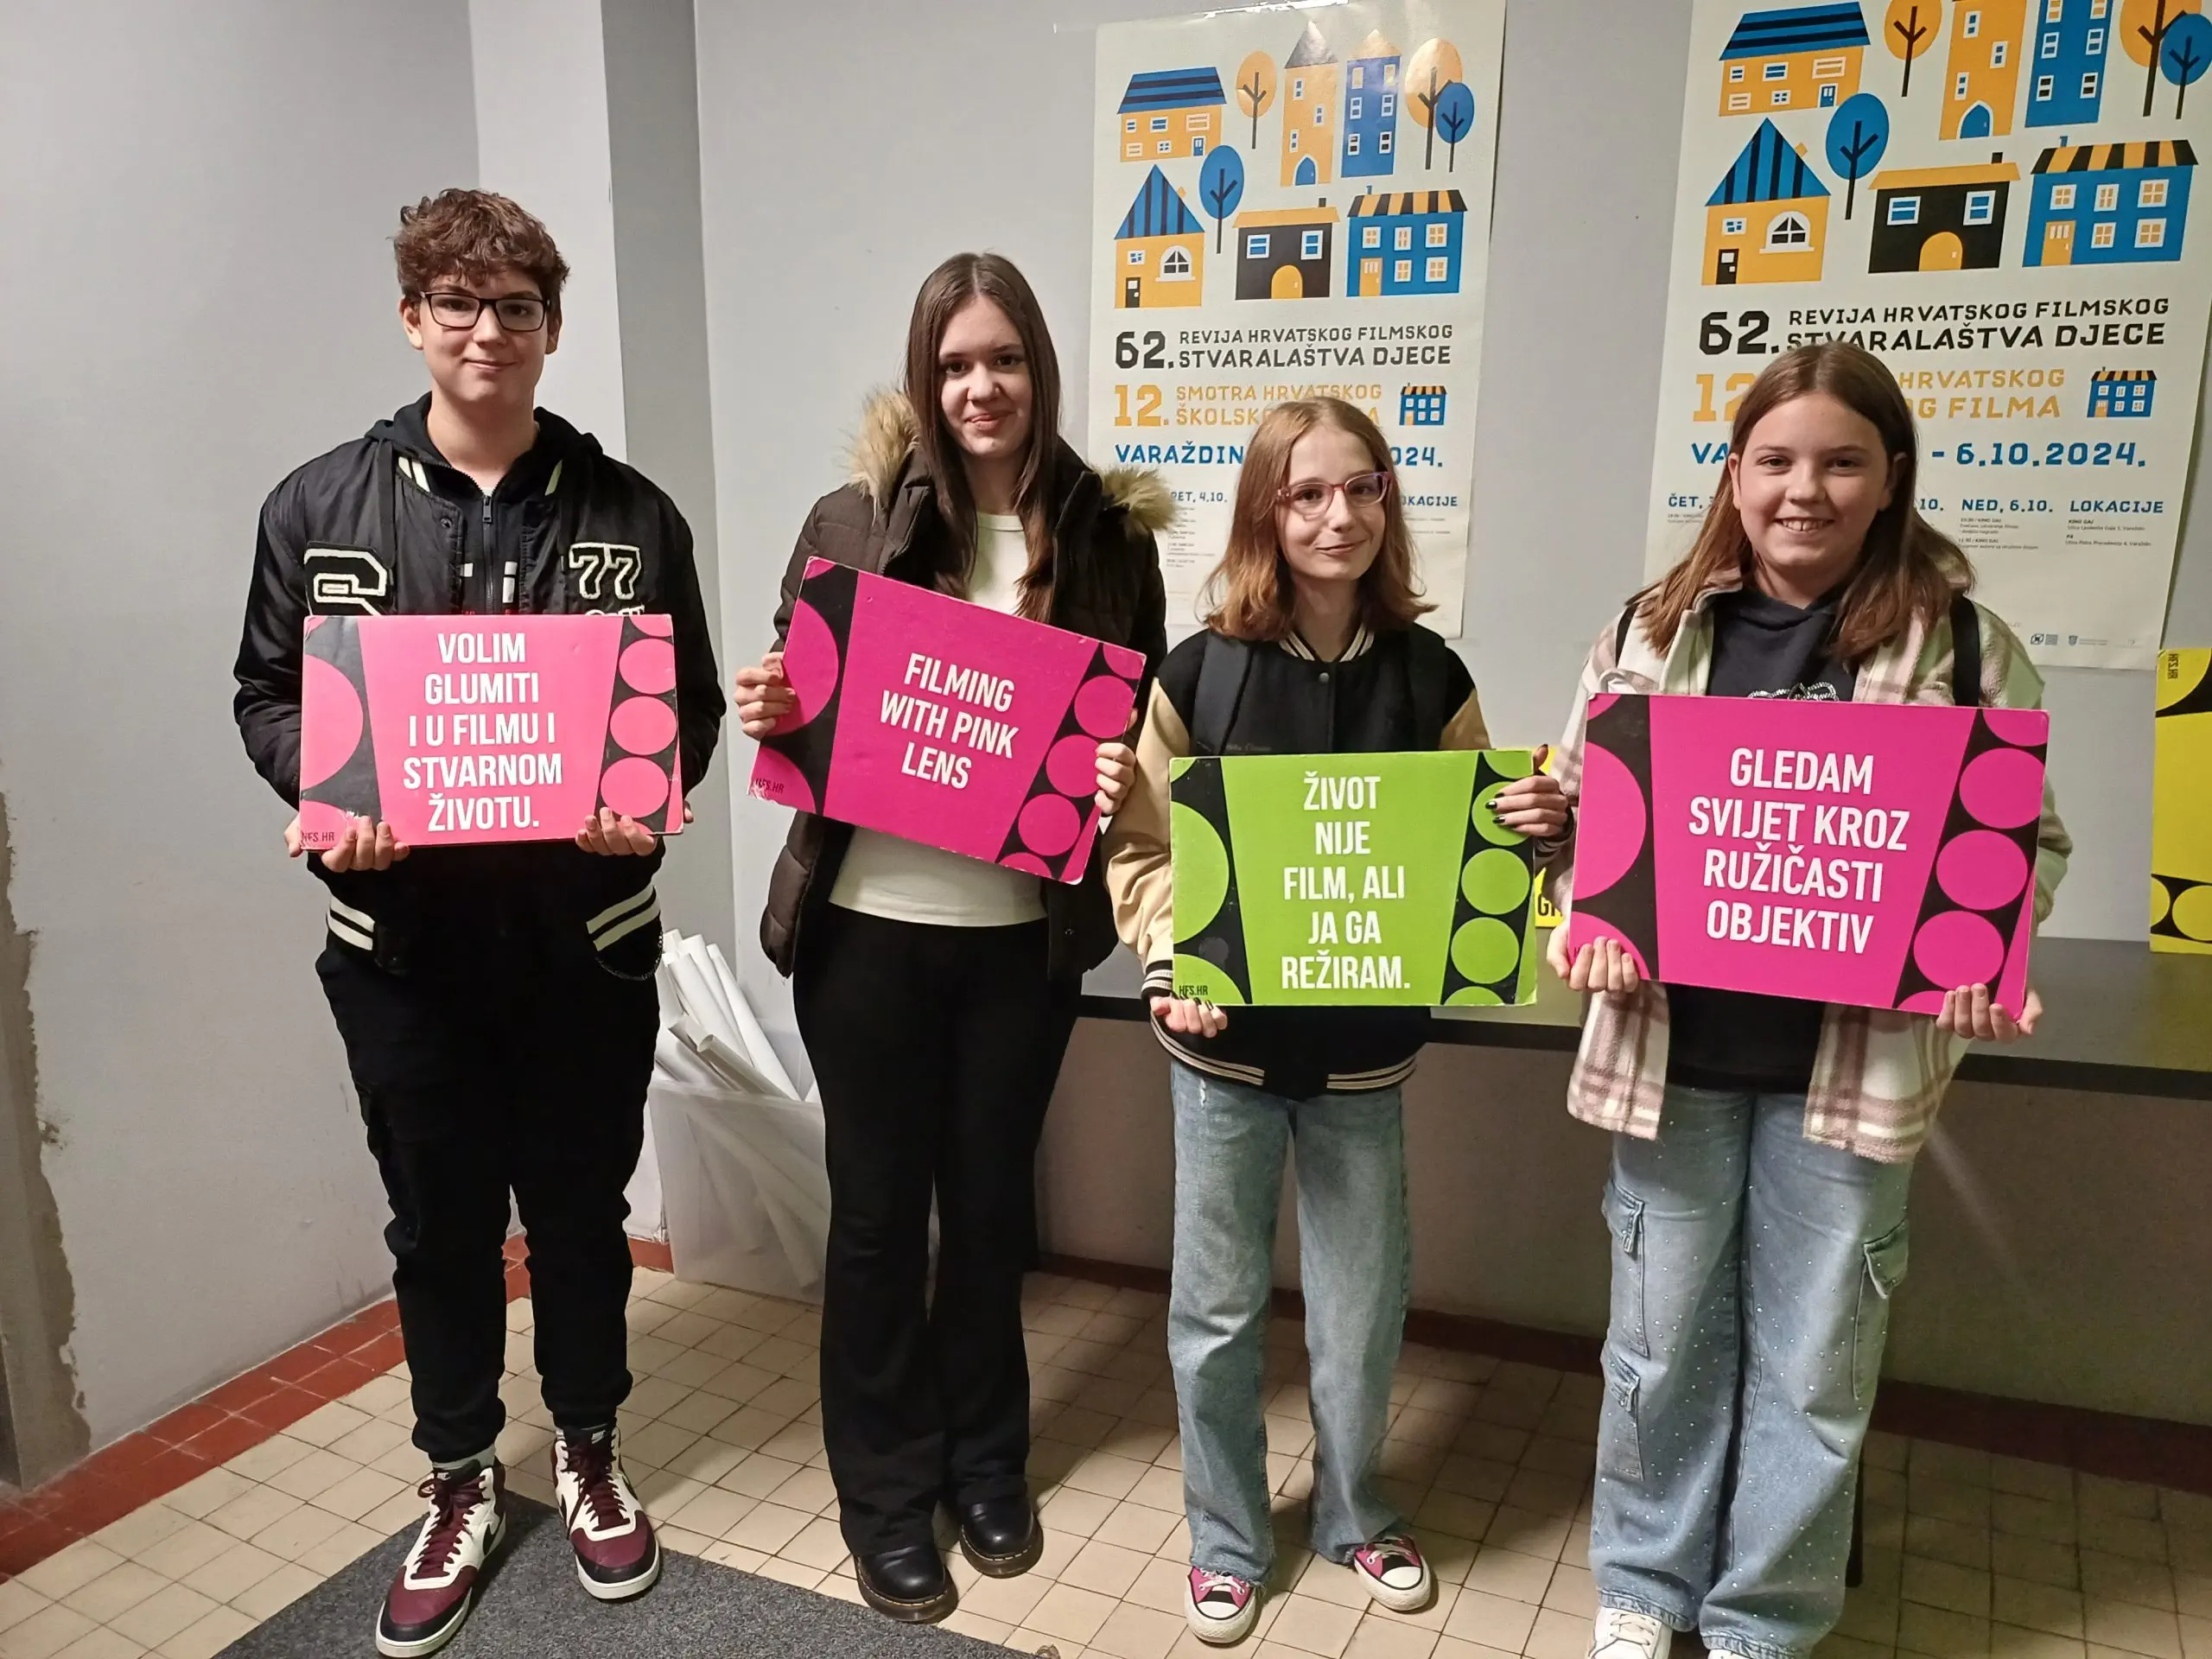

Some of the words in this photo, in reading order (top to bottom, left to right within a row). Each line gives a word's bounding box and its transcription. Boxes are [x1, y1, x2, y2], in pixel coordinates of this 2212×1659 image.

[1789, 308, 1876, 326] REVIJA
[1884, 303, 2027, 322] HRVATSKOG
[2036, 299, 2170, 318] FILMSKOG
[1116, 330, 1174, 369] 62.
[1179, 330, 1243, 344] REVIJA
[1249, 327, 1352, 343] HRVATSKOG
[1357, 325, 1452, 340] FILMSKOG
[1700, 310, 1779, 355] 62.
[2056, 322, 2164, 346] DJECE
[1179, 343, 1365, 368] STVARALAŠTVA
[1373, 346, 1452, 365] DJECE
[1176, 385, 1256, 402] SMOTRA
[1898, 369, 2065, 390] HRVATSKOG
[1114, 385, 1169, 427] 12.
[1176, 403, 1268, 425] ŠKOLSK
[1948, 395, 2061, 419] FILMA
[1115, 441, 1244, 465] VARAŽDIN
[1956, 442, 2146, 467] 6.10.2024.
[1199, 492, 1228, 503] 4.10.
[1668, 493, 1703, 510] ČET,
[1961, 499, 2004, 513] NED,
[2010, 499, 2053, 512] 6.10.
[2069, 499, 2164, 513] LOKACIJE
[569, 542, 641, 600] 77
[437, 632, 525, 664] VOLIM
[424, 673, 539, 705] GLUMITI
[903, 652, 1015, 713] FILMING
[409, 715, 416, 747] I
[425, 715, 445, 746] U
[453, 714, 540, 744] FILMU
[546, 713, 556, 743] I
[880, 689, 944, 738] WITH
[950, 711, 1020, 760] PINK
[403, 753, 563, 790] STVARNOM
[900, 741, 972, 790] LENS
[1730, 747, 1874, 796] GLEDAM
[1303, 771, 1381, 811] ŽIVOT
[428, 792, 540, 832] ŽIVOTU.
[1688, 797, 1805, 842] SVIJET
[1814, 804, 1910, 851] KROZ
[1314, 821, 1371, 855] NIJE
[1283, 866, 1355, 904] FILM,
[1363, 865, 1405, 899] ALI
[1703, 842, 1884, 903] RUŽIČASTI
[1308, 911, 1338, 945] JA
[1344, 910, 1382, 944] GA
[1706, 899, 1874, 955] OBJEKTIV
[1281, 949, 1411, 989] REŽIRAM.
[1179, 985, 1209, 996] HFS.HR
